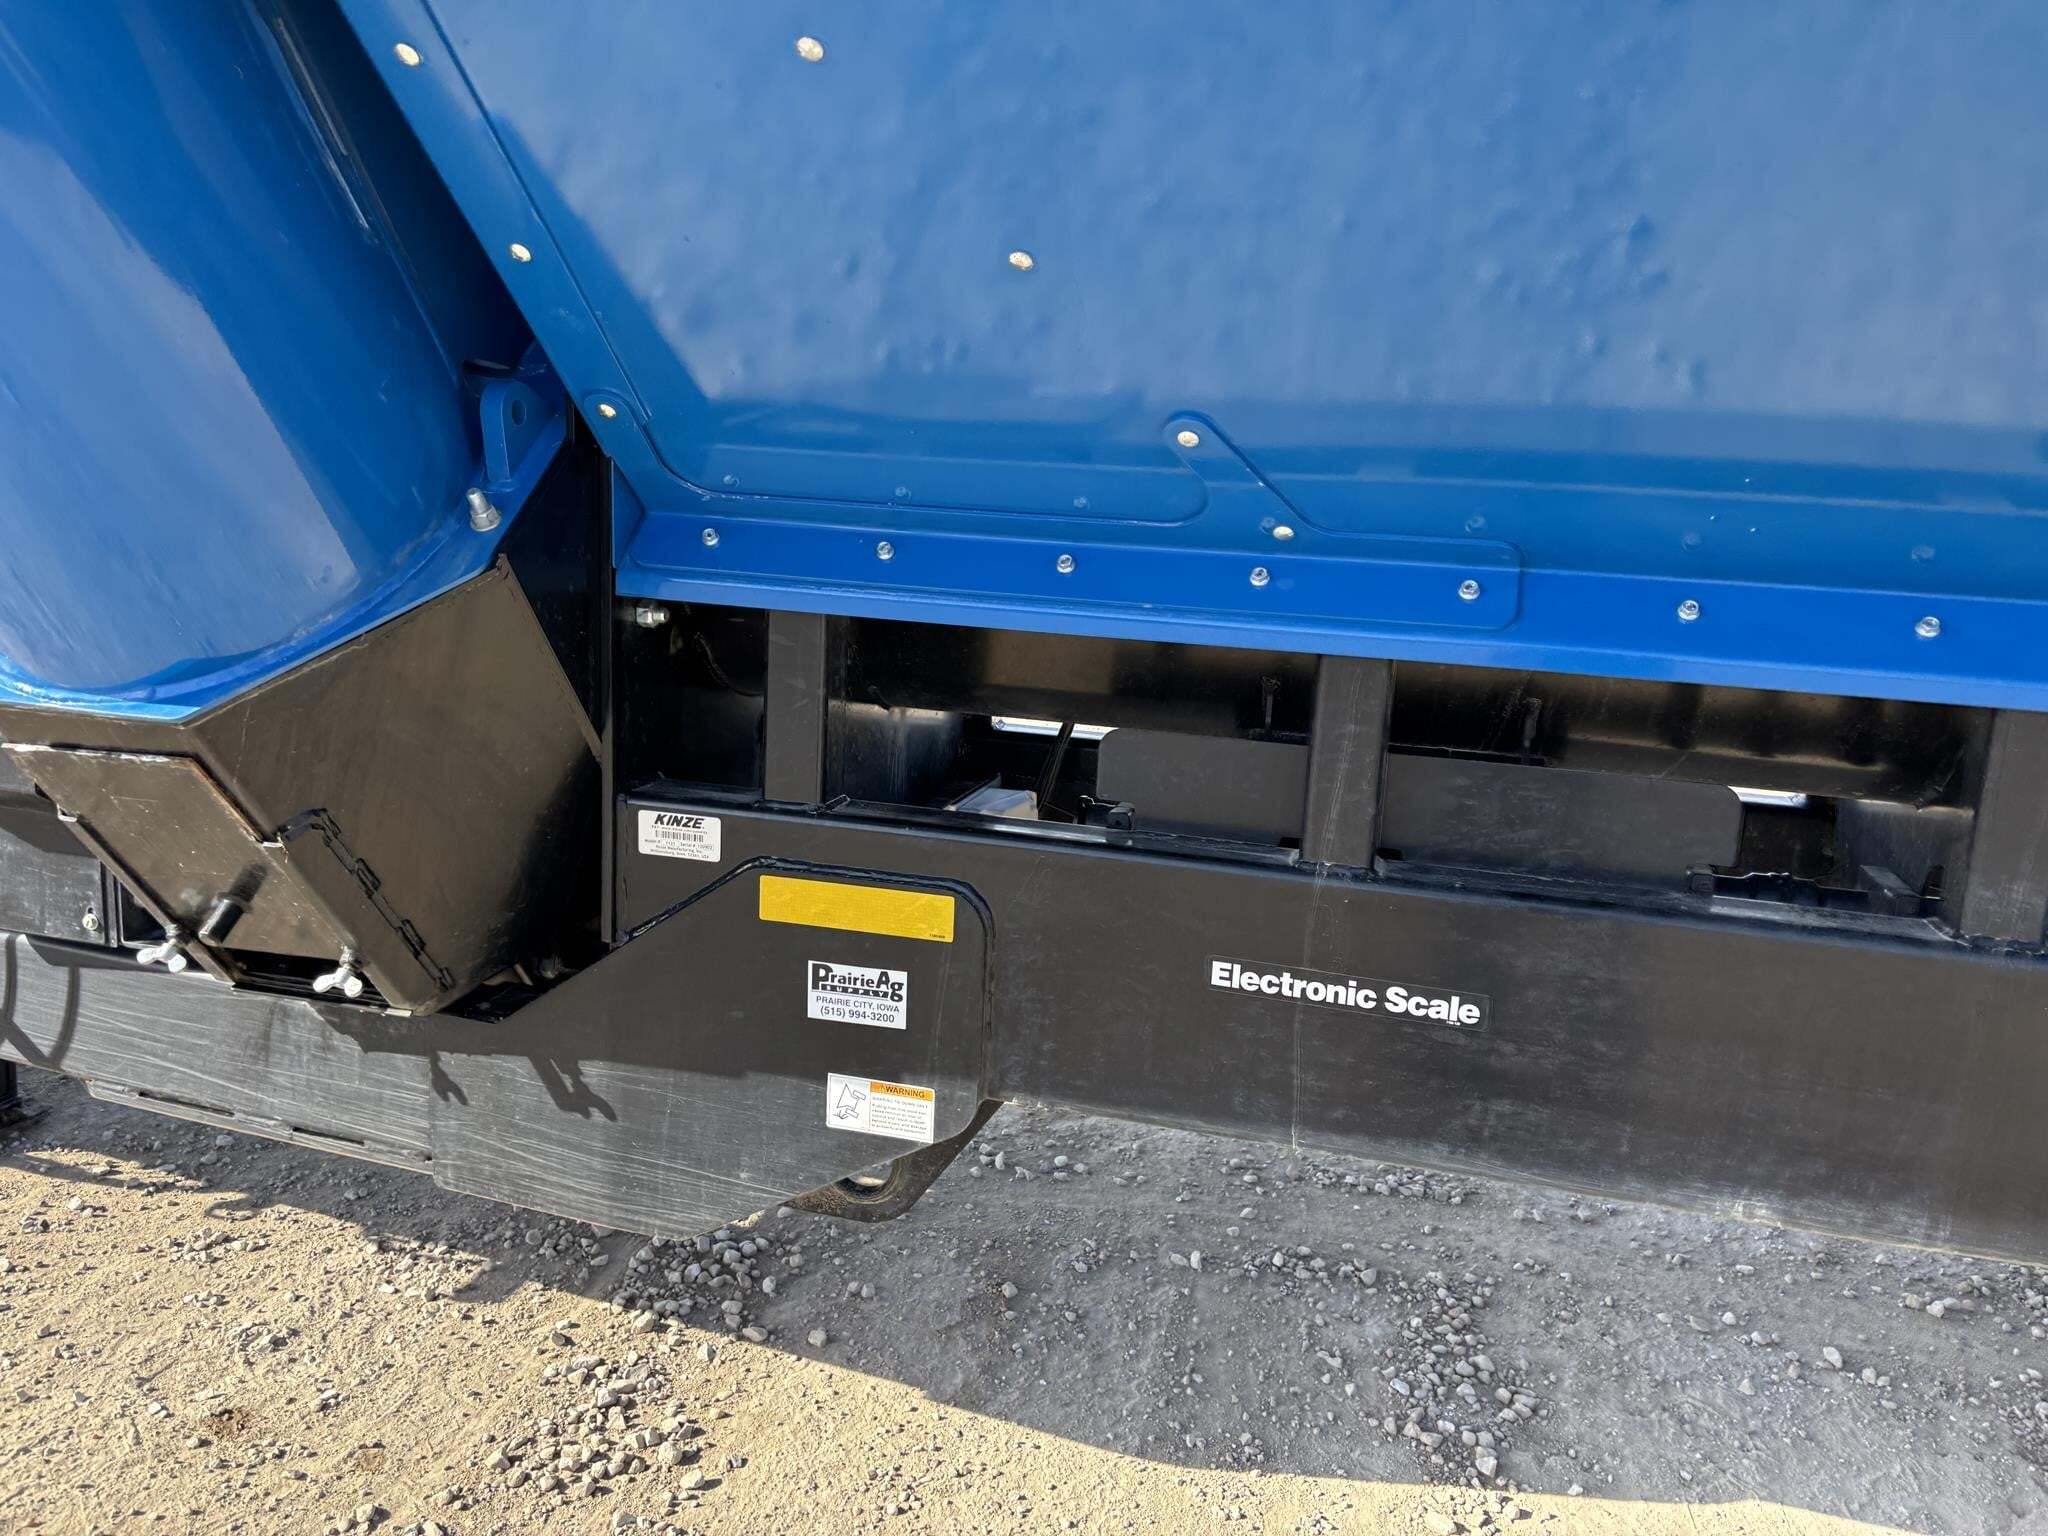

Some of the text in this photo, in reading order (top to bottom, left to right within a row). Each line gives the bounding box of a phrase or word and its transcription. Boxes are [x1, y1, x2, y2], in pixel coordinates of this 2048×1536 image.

[655, 813, 704, 829] KINZE
[826, 985, 885, 998] SUPPLY
[1210, 960, 1481, 1024] Electronic Scale
[816, 995, 900, 1013] PRAIRIE CITY, IOWA
[820, 1006, 895, 1023] (515) 994-3200
[885, 1085, 925, 1099] WARNING
